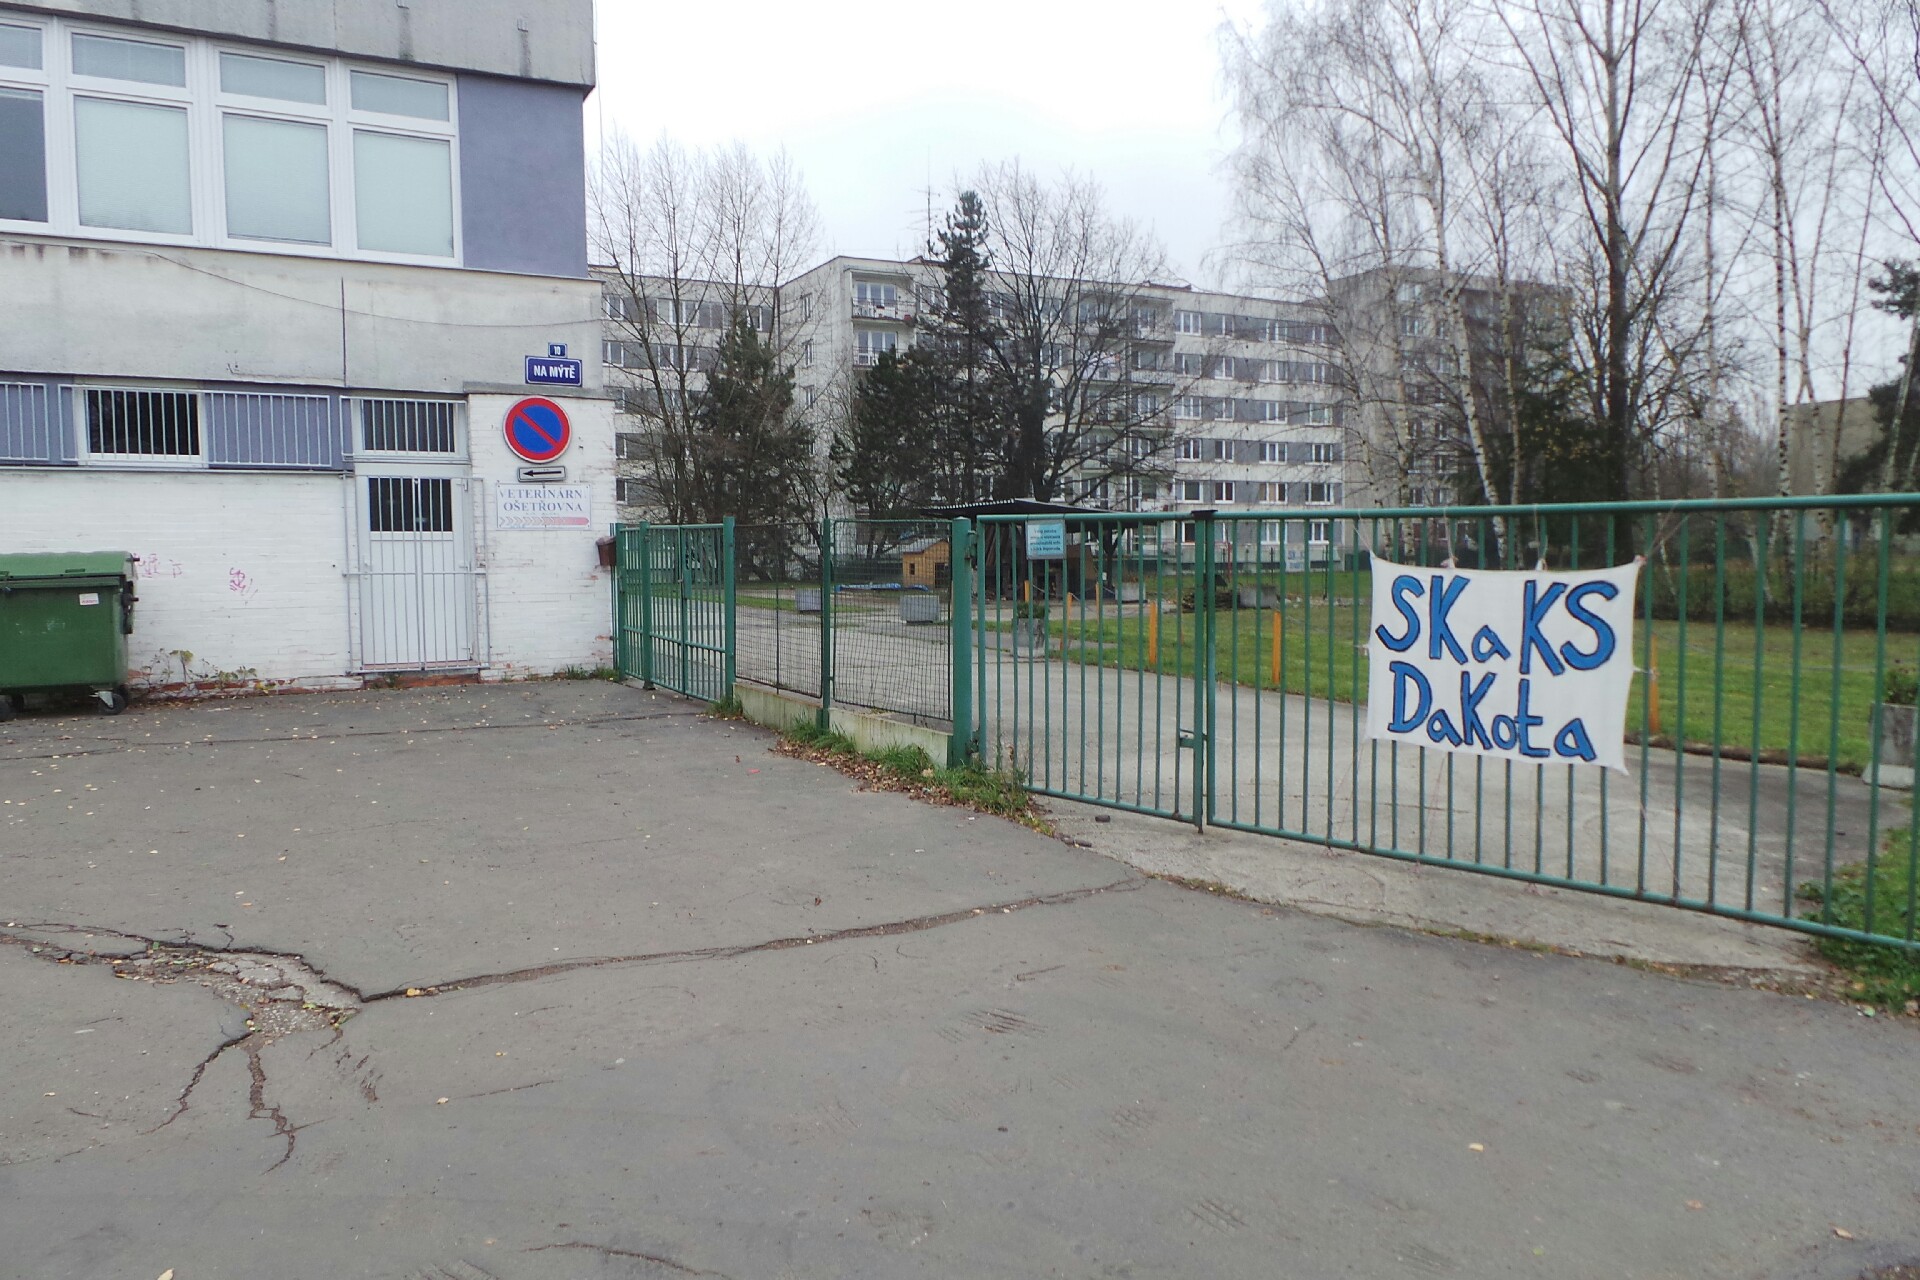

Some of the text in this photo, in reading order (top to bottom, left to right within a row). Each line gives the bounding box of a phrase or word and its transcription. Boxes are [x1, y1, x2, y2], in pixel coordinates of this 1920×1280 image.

[553, 345, 562, 356] 10
[533, 364, 576, 379] NA MÝTĚ
[503, 500, 583, 512] OŠETŘOVNA
